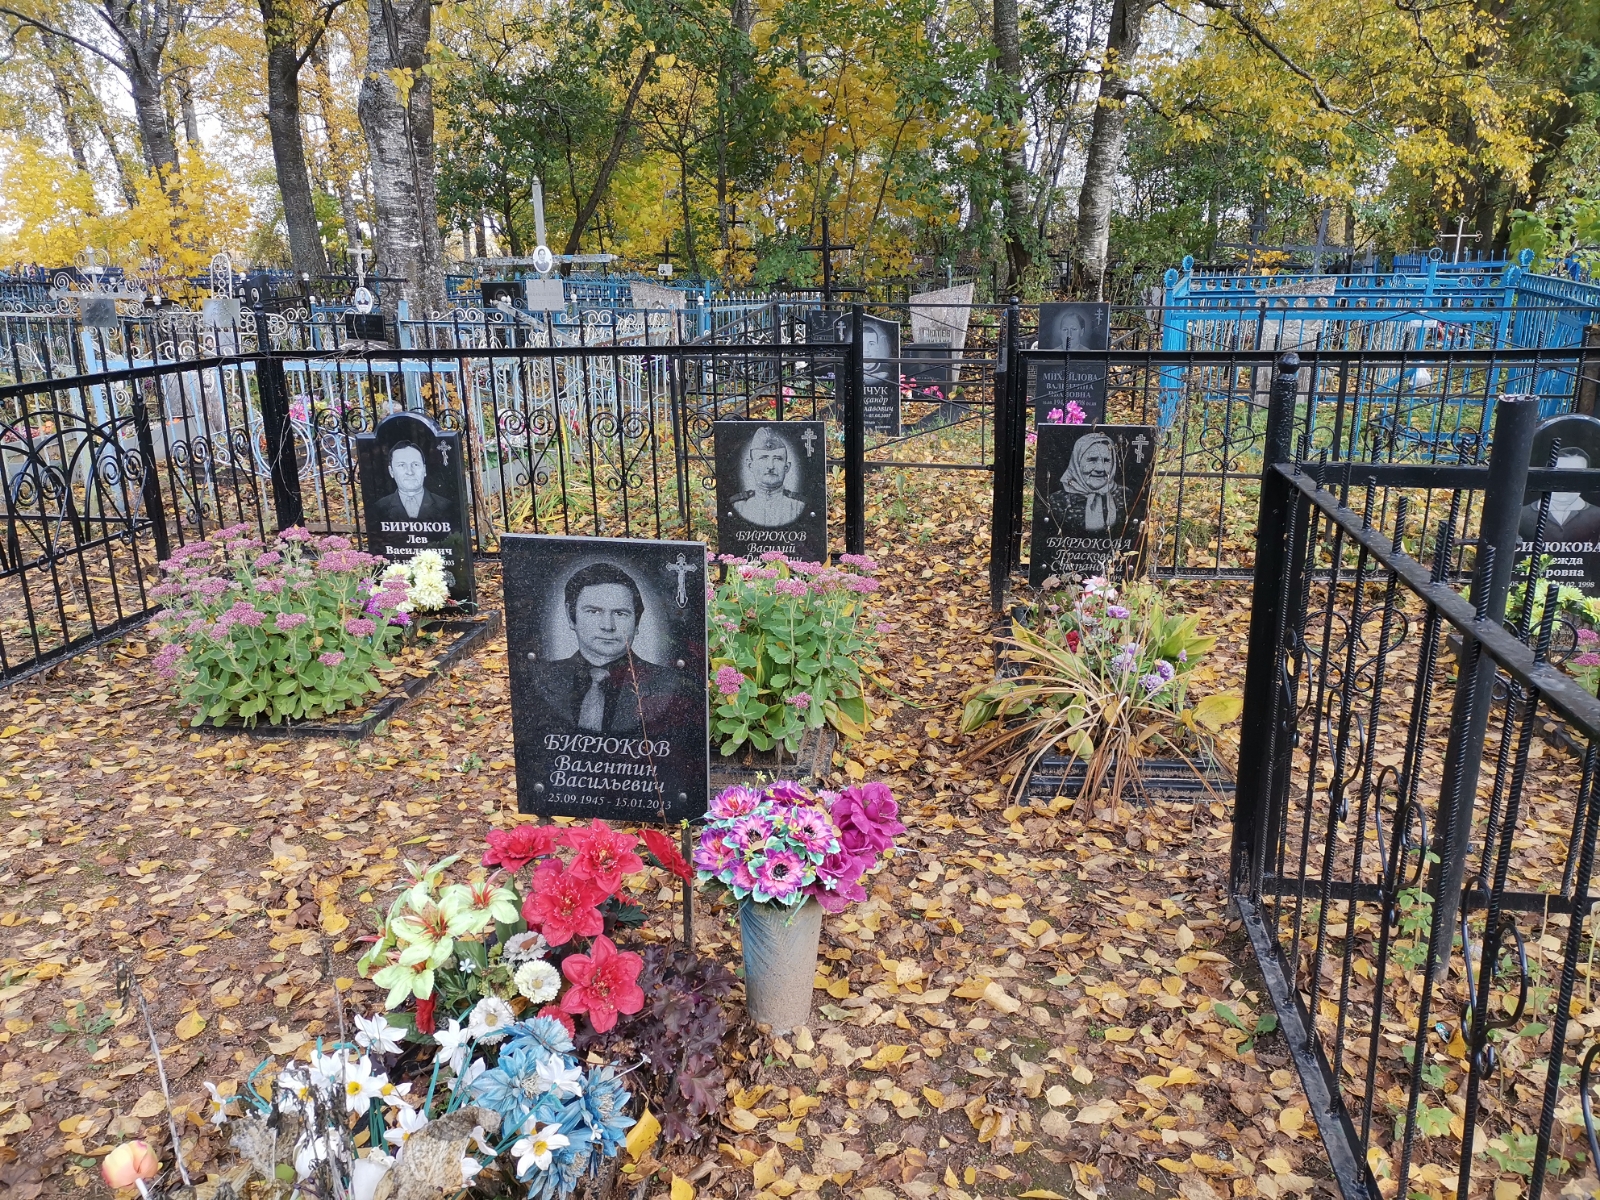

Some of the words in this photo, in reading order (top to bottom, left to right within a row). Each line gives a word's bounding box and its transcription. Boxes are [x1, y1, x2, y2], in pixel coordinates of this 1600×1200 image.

[1042, 372, 1098, 381] МИХЙЛОВА
[380, 521, 451, 533] БИРЮКОВ
[406, 534, 428, 544] Лев
[735, 530, 807, 544] БИРЮКОВ
[1046, 536, 1132, 551] БИРЮКОВА
[543, 733, 671, 760] БИРЮКОВ
[554, 754, 658, 777] Валентин
[549, 770, 665, 794] Васильевич
[547, 793, 604, 806] 25.09.1945
[614, 797, 672, 811] 15.01.203
